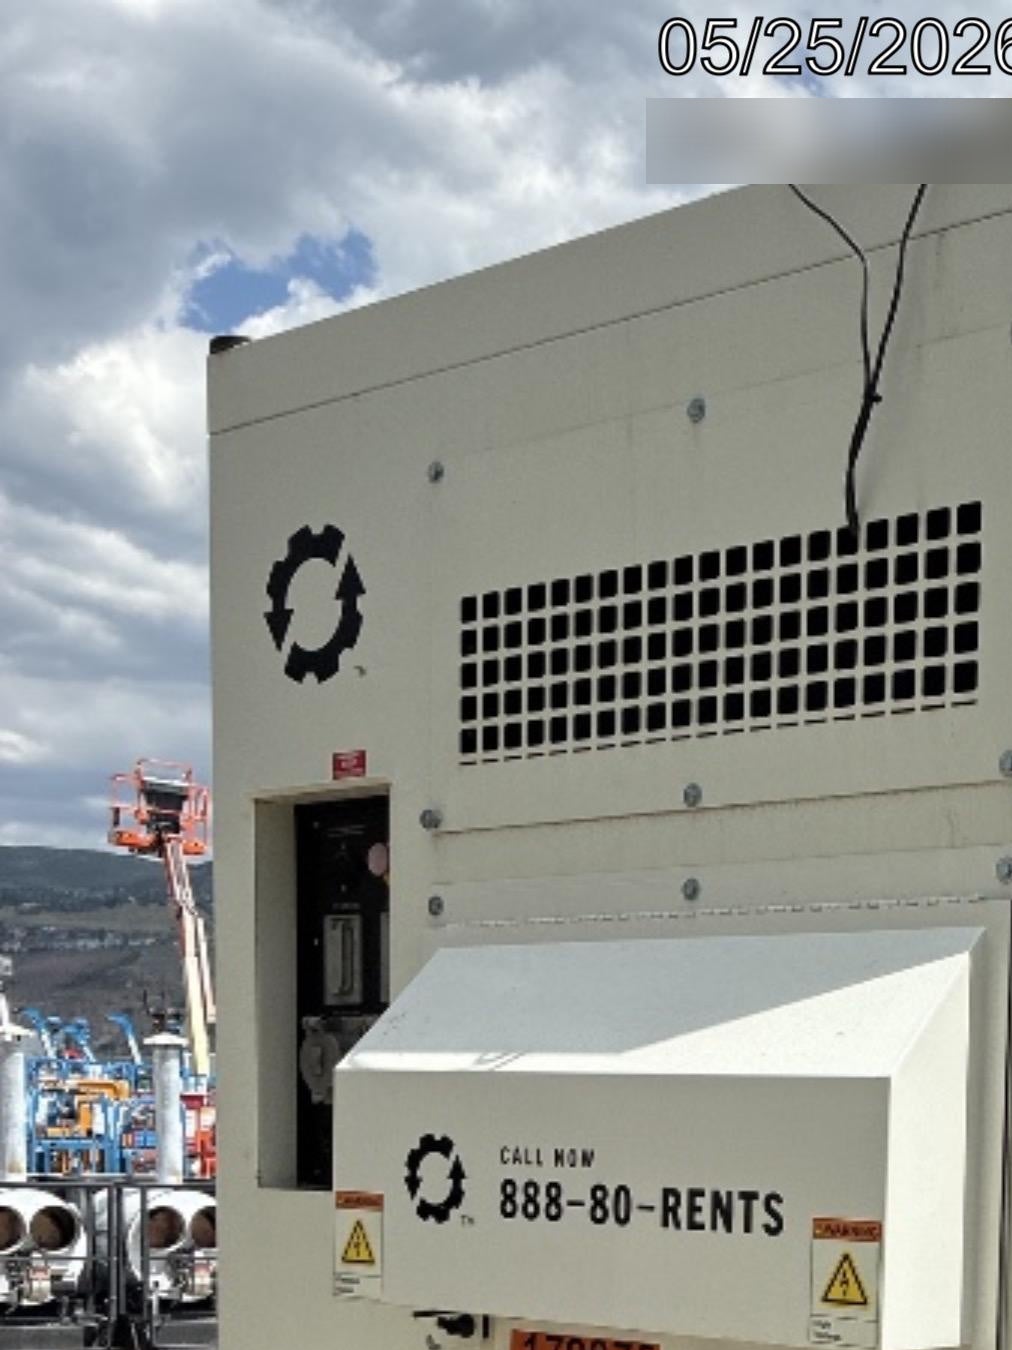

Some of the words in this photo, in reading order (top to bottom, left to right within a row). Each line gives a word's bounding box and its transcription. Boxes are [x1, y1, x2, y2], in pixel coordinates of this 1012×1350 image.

[500, 1145, 543, 1167] CALL
[554, 1147, 595, 1168] NOW
[500, 1178, 784, 1237] 888-80-RENTS
